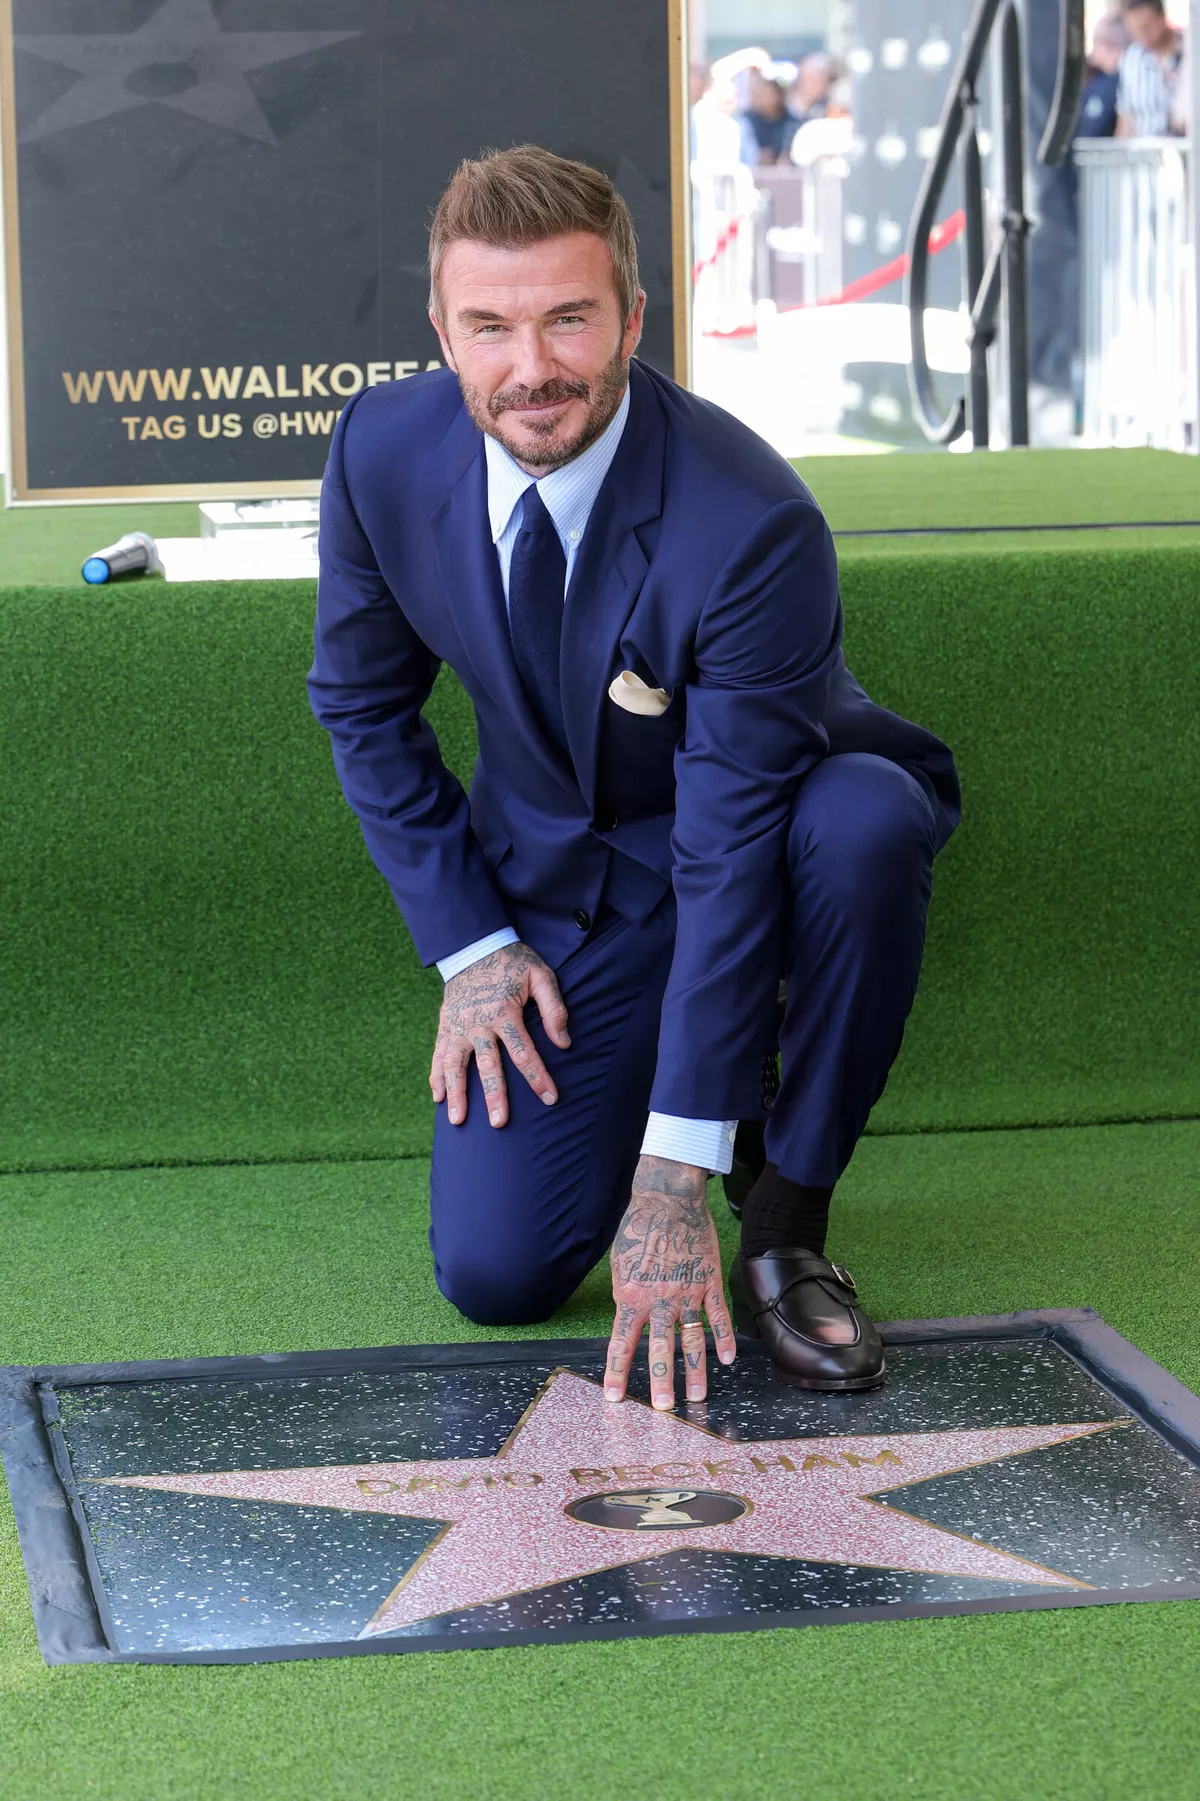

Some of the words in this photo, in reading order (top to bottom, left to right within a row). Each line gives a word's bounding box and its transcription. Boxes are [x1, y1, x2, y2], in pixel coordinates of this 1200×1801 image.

[122, 415, 187, 440] TAG
[197, 413, 243, 438] US
[253, 410, 342, 439] @HW
[356, 1472, 543, 1497] DAVID
[569, 1449, 901, 1485] BECKHAM
